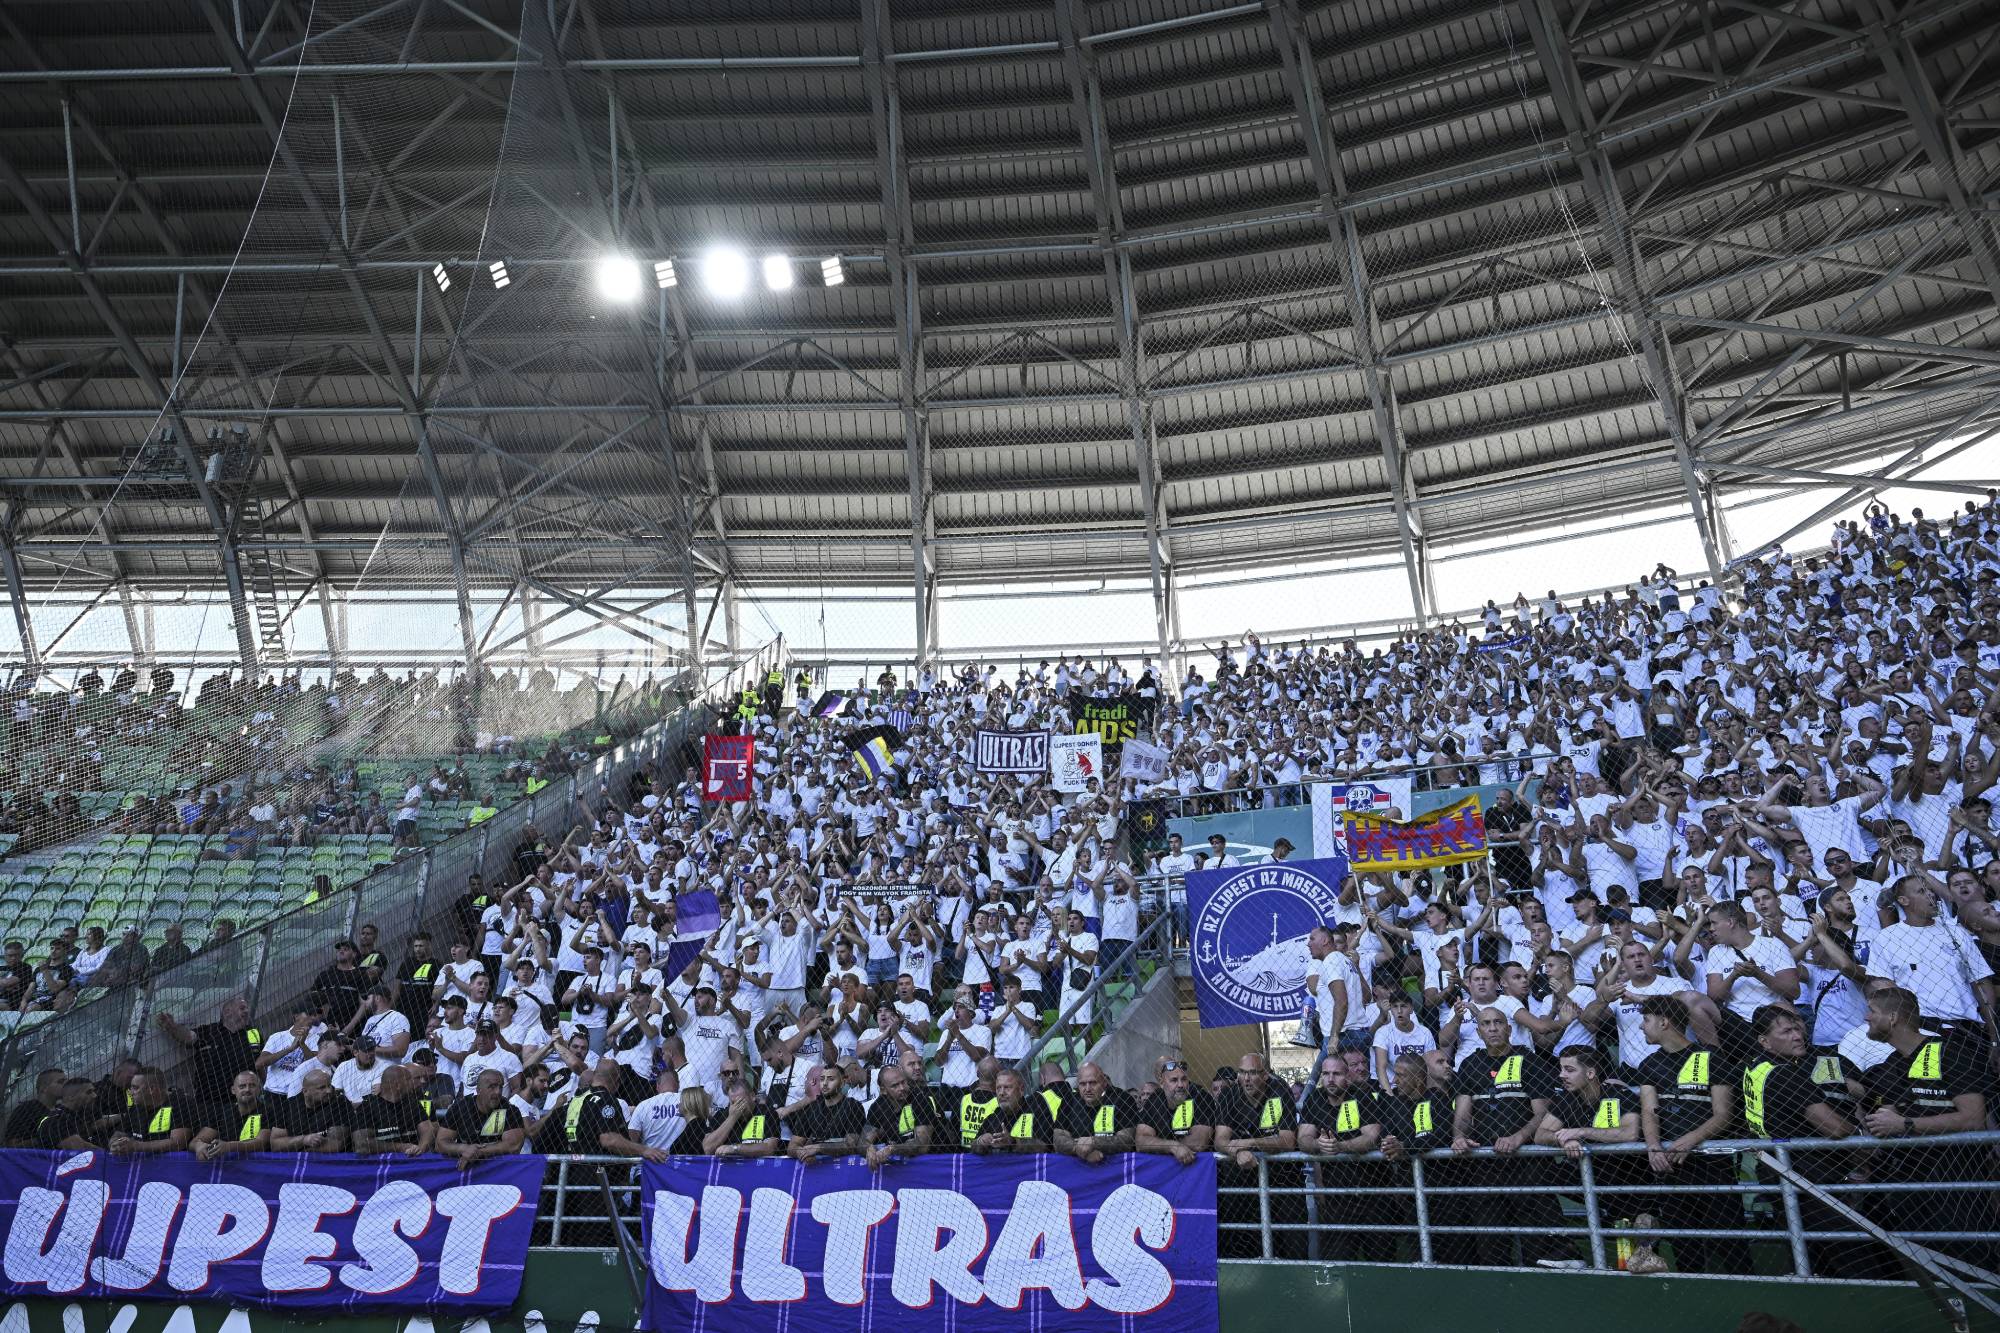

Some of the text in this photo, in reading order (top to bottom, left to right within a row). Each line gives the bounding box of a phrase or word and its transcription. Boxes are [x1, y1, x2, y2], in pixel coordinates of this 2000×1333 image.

[1084, 704, 1127, 719] fradi
[1075, 719, 1137, 744] AIDS
[982, 736, 1043, 767] ULTRAS
[1350, 829, 1484, 863] ULTRAS
[1260, 871, 1278, 886] AZ
[1209, 874, 1256, 915] ÚJPEST
[1203, 914, 1220, 932] AZ
[3, 1150, 523, 1294] ÚJPEST
[651, 1181, 1177, 1315] ULTRAS
